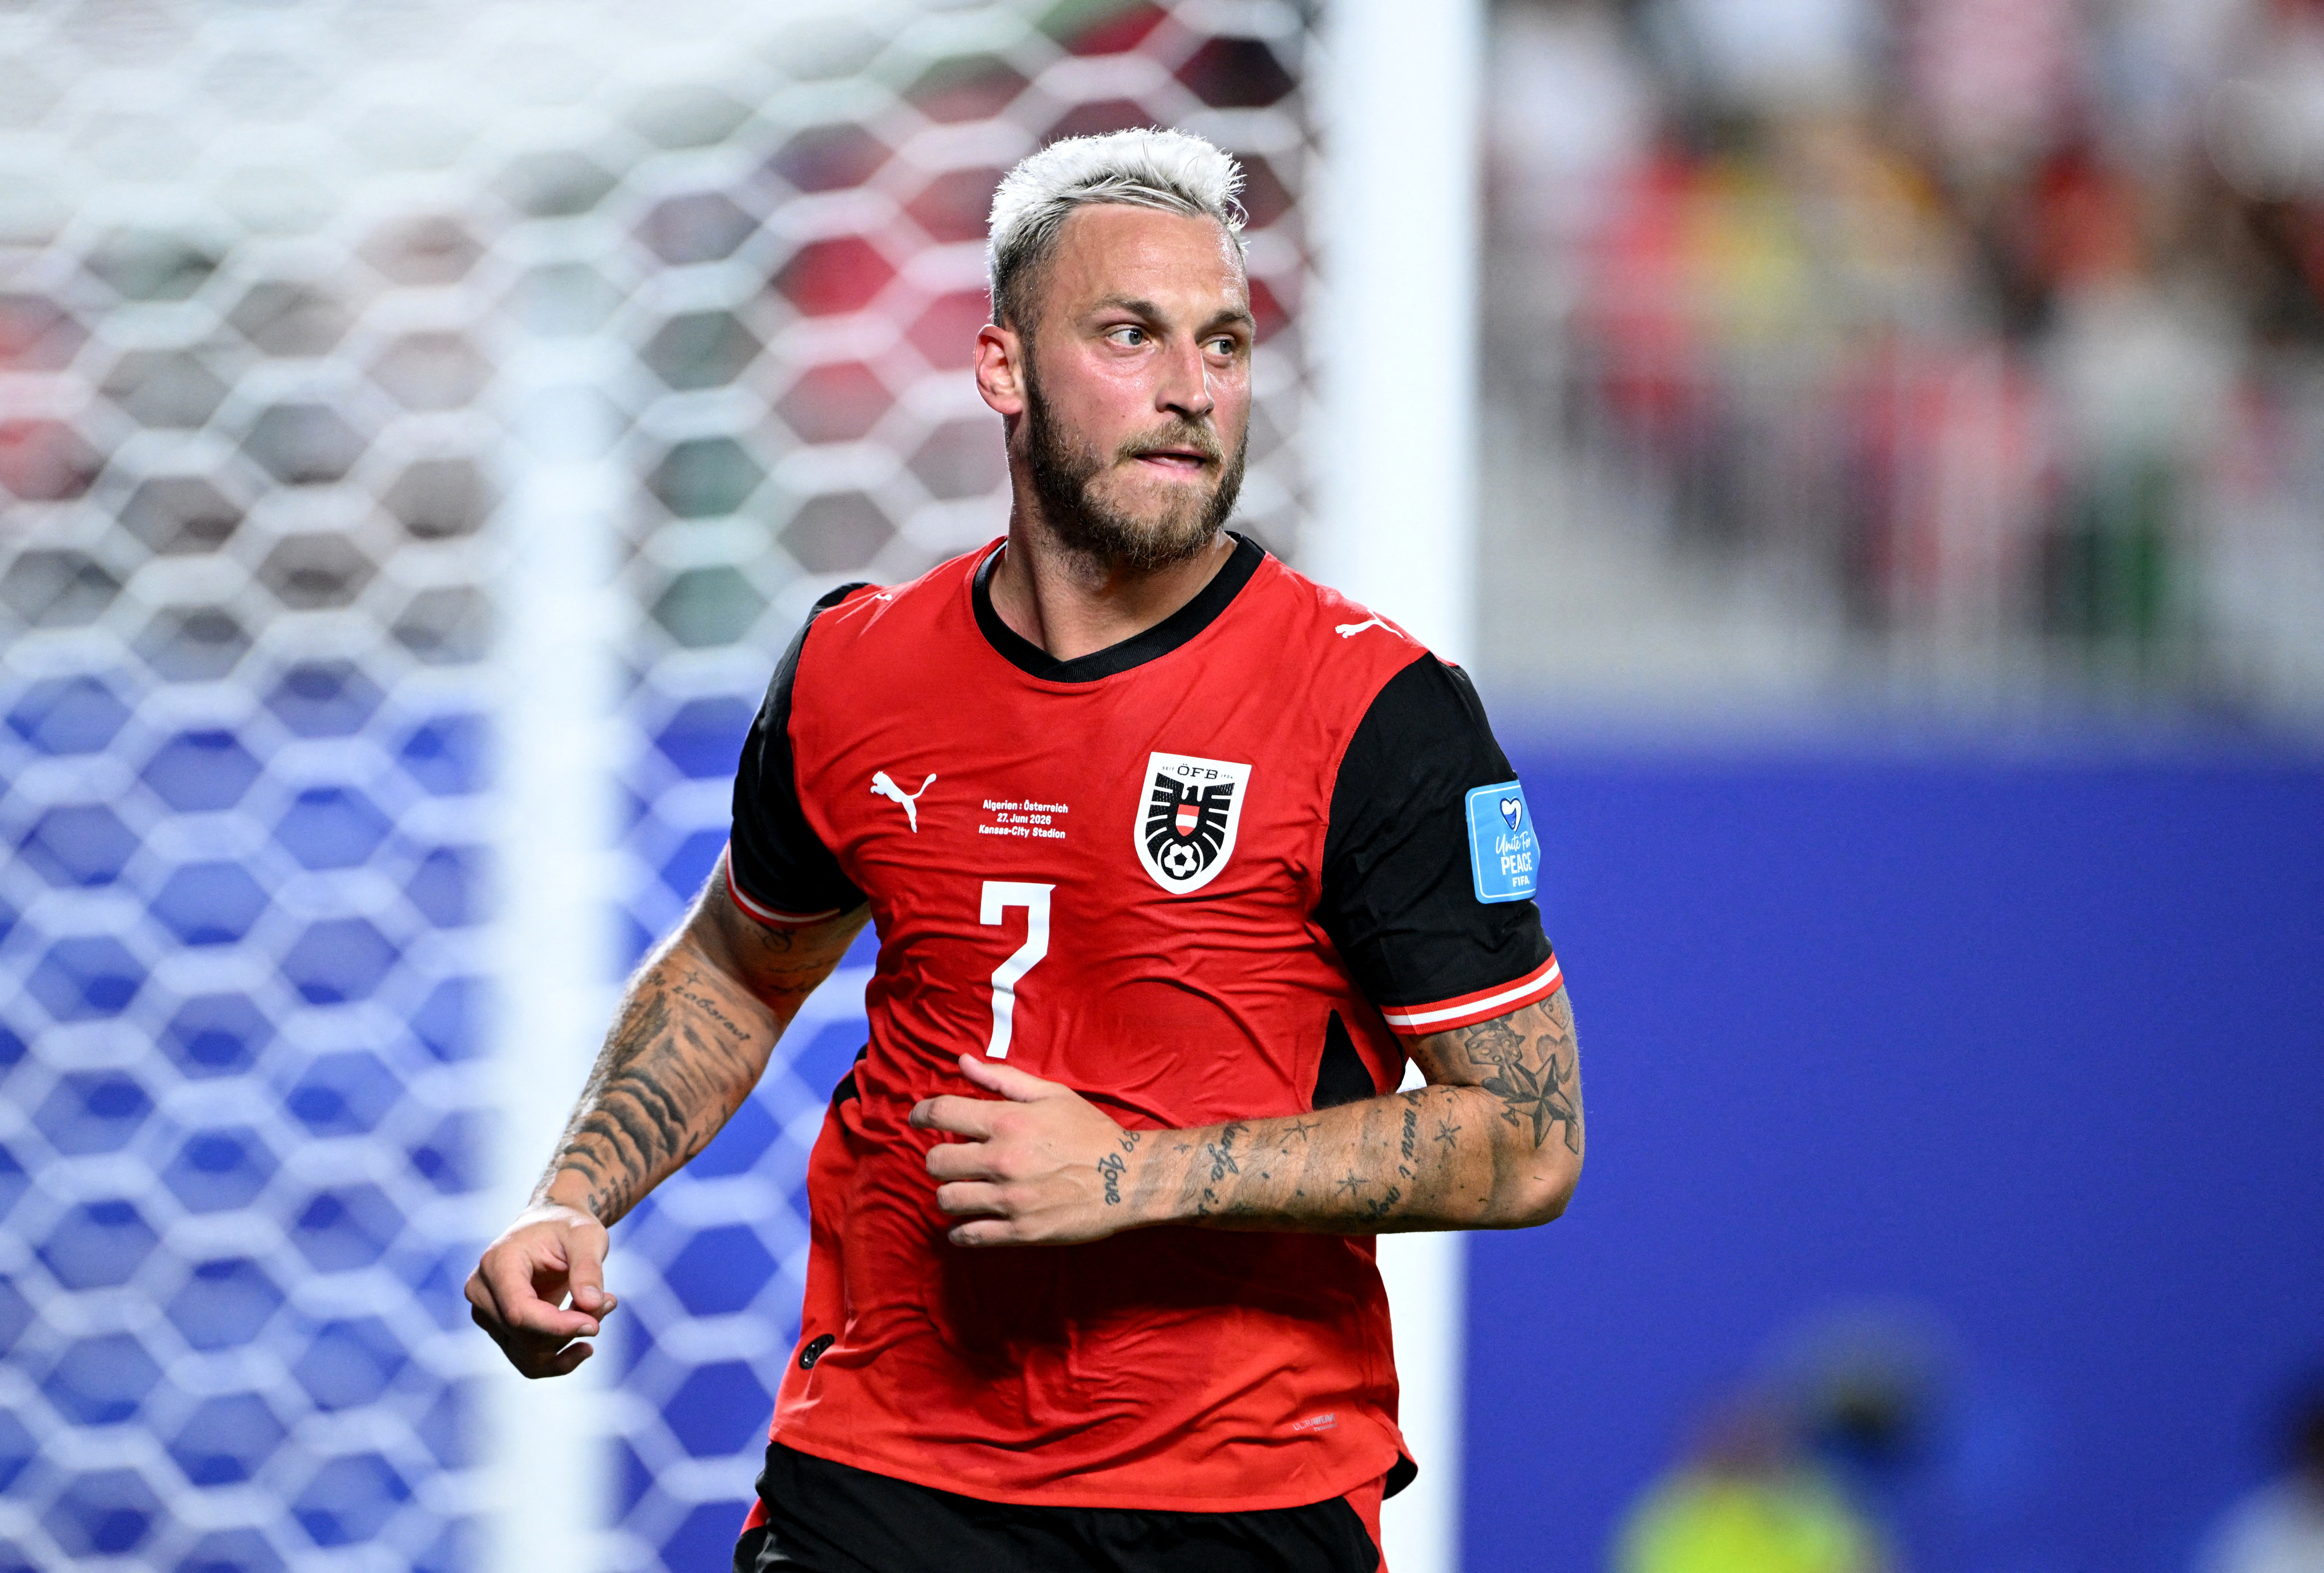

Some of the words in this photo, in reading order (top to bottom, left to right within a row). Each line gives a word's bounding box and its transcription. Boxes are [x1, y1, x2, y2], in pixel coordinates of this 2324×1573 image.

[1177, 763, 1218, 780] ÖFB
[982, 799, 1018, 811] Algerien
[1023, 799, 1068, 813] Österreich
[997, 813, 1009, 823] 27.
[1010, 813, 1028, 823] Juni
[1029, 814, 1052, 825] 2026
[979, 824, 1030, 838] Kansas-City
[1032, 827, 1066, 839] Stadion
[1495, 834, 1521, 856] Unite
[1520, 831, 1531, 851] For
[1501, 852, 1533, 875] PEACE
[1512, 875, 1529, 887] FIFA
[980, 881, 1056, 1059] 7
[1098, 1153, 1127, 1206] Love
